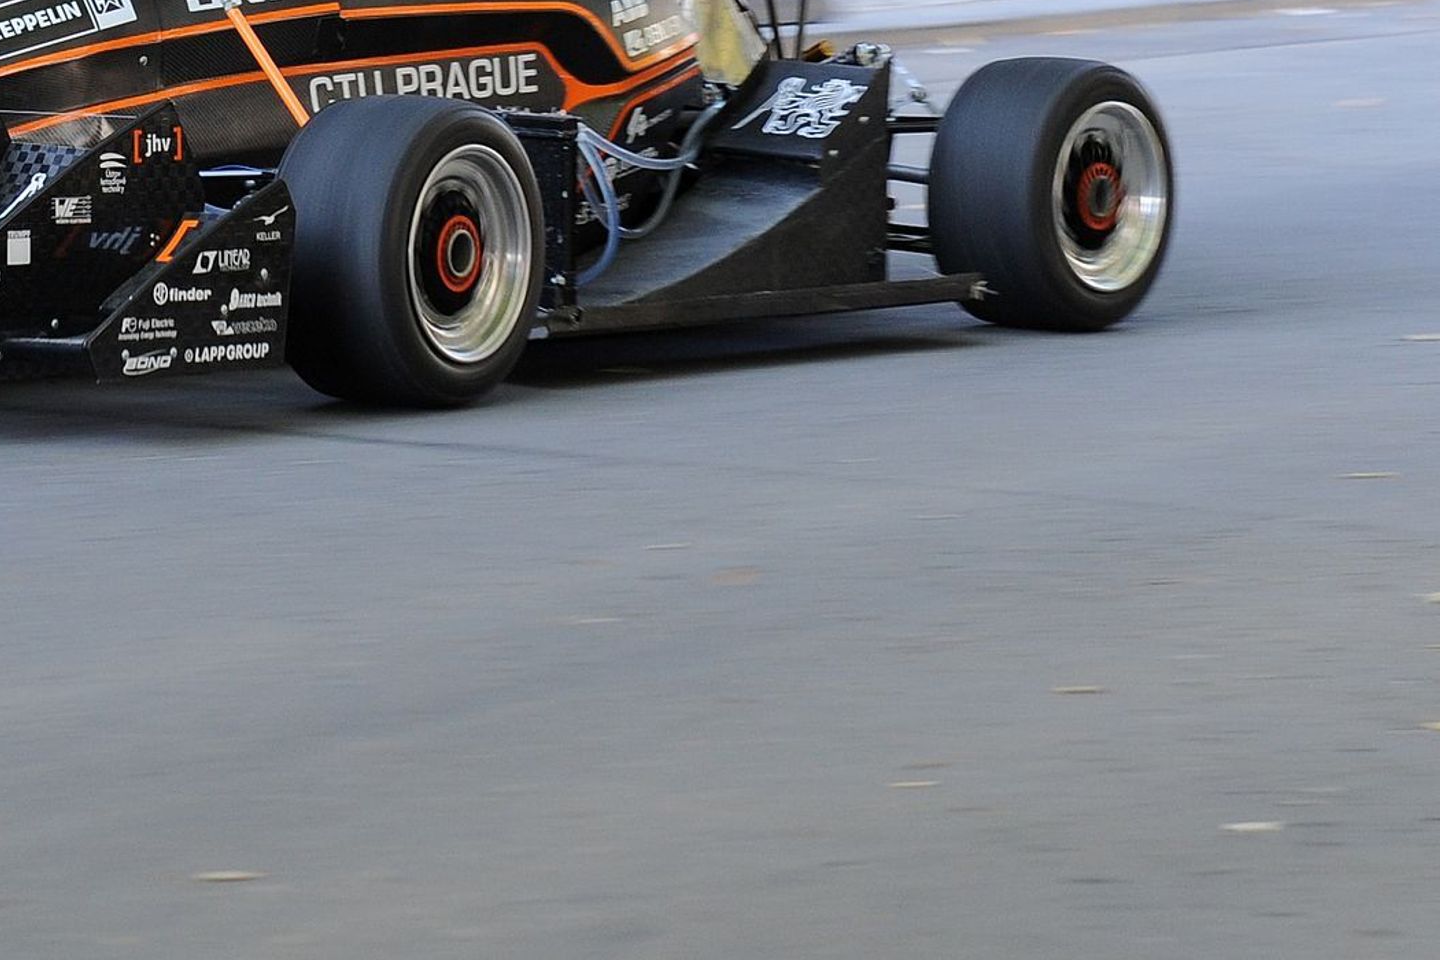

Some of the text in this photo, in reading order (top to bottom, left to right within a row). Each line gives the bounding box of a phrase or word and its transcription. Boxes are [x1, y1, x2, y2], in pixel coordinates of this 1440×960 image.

[309, 53, 539, 114] CTU PRAGUE
[145, 134, 171, 157] jhv
[256, 231, 281, 241] KELLER
[218, 248, 250, 268] LINEAR
[169, 287, 212, 302] finder
[194, 342, 270, 363] LAPP GROUP
